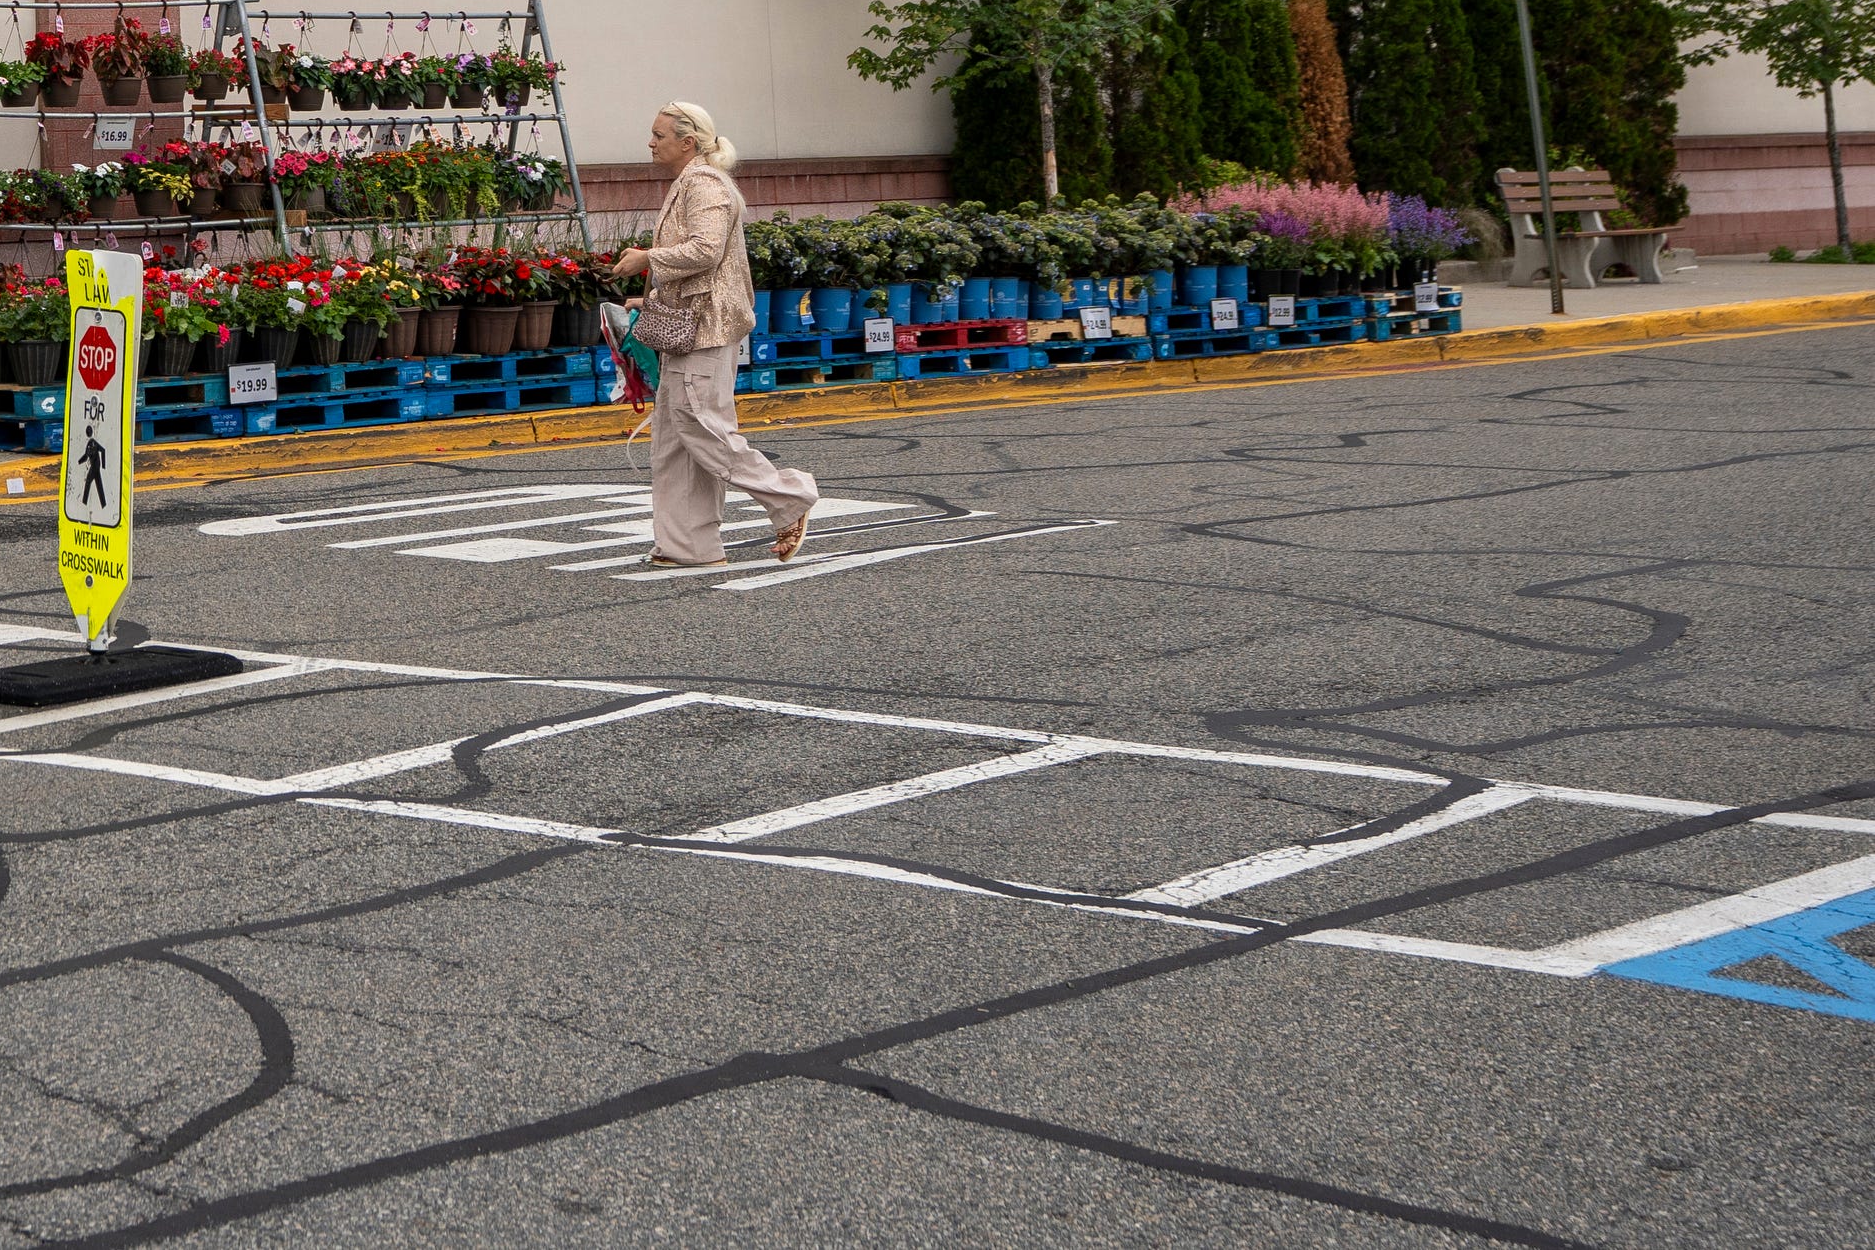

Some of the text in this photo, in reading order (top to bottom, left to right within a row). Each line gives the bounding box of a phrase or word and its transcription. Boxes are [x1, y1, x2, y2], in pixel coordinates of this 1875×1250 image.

[101, 130, 128, 142] $16.99
[869, 331, 890, 343] $24.99
[80, 344, 114, 372] STOP
[236, 378, 268, 393] $19.99
[84, 399, 105, 422] FOR
[74, 528, 110, 552] WITHIN
[61, 550, 124, 581] CROSSWALK
